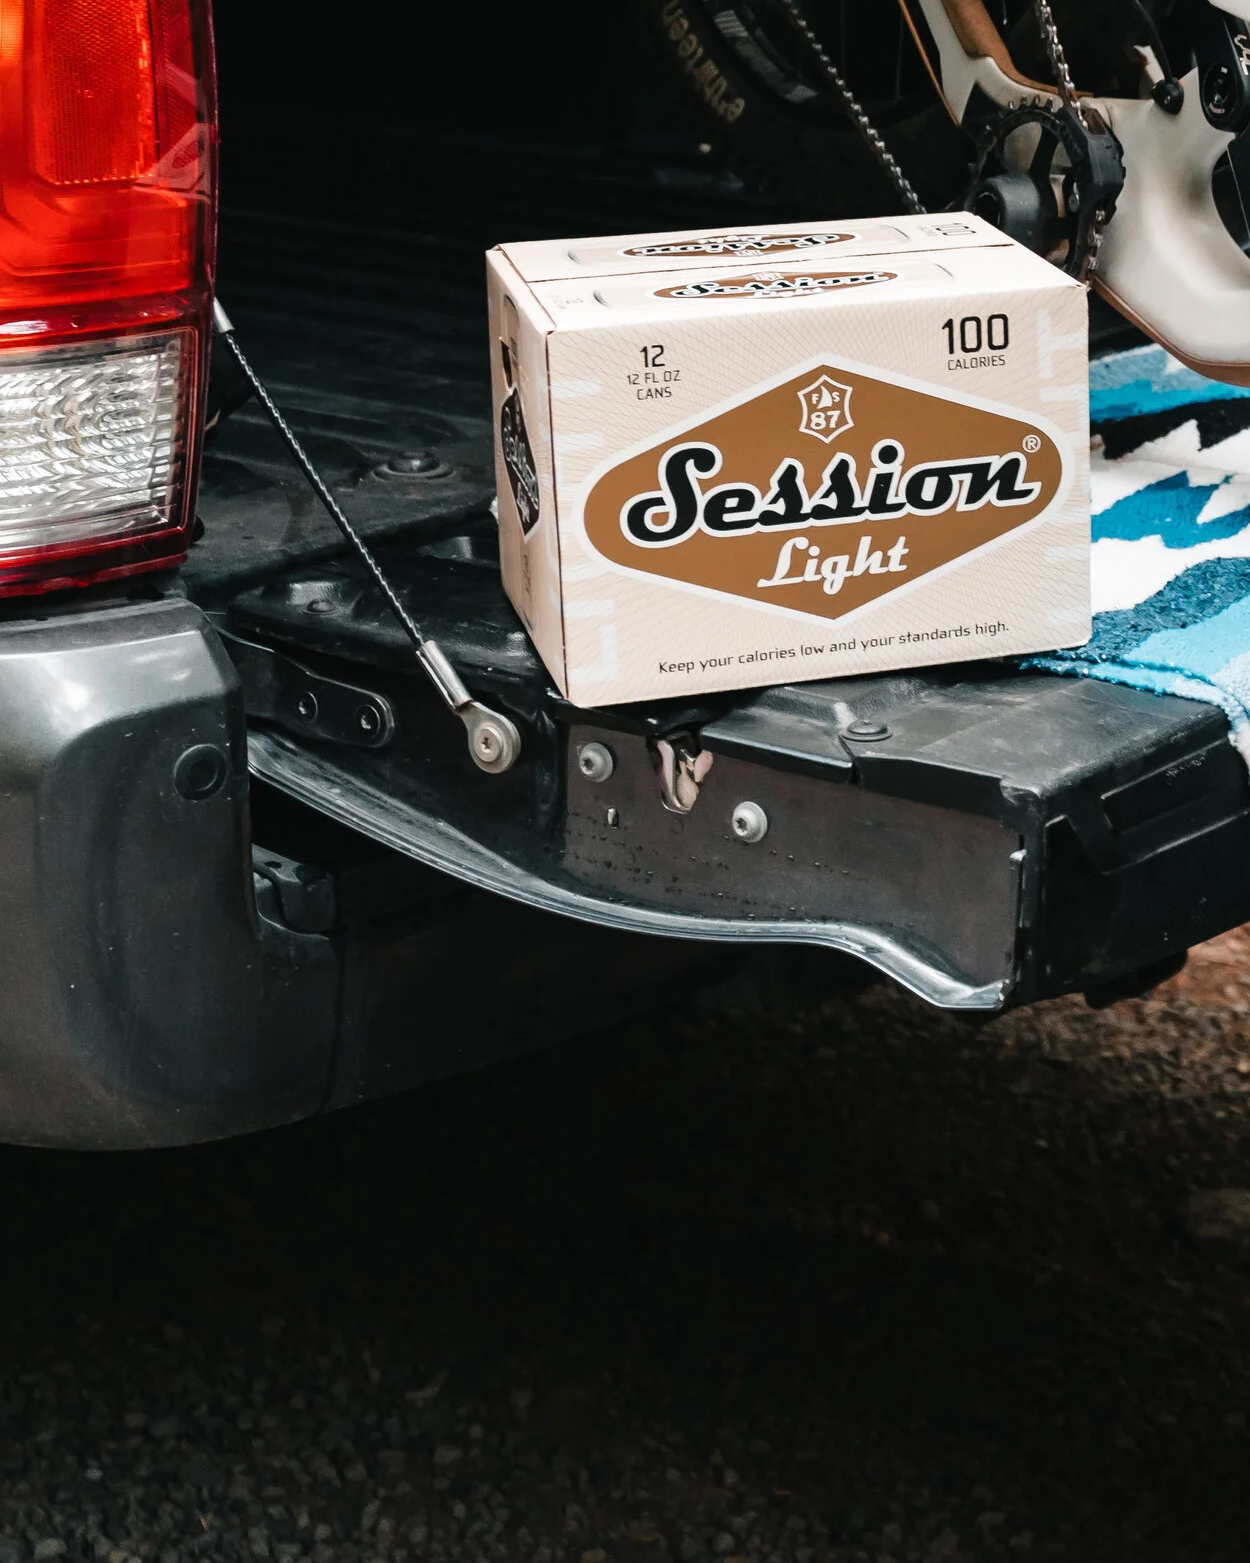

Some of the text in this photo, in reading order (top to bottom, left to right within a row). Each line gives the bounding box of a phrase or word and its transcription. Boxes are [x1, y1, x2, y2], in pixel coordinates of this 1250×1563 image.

[941, 313, 1010, 355] 100
[639, 344, 667, 369] 12
[946, 354, 1006, 371] CALORIES
[626, 369, 682, 386] 12 FL OZ
[636, 386, 673, 401] CANS
[811, 391, 841, 405] F S
[809, 409, 842, 431] 87
[756, 536, 910, 596] Light
[658, 621, 1011, 675] Keep your calories low and your standards high.
